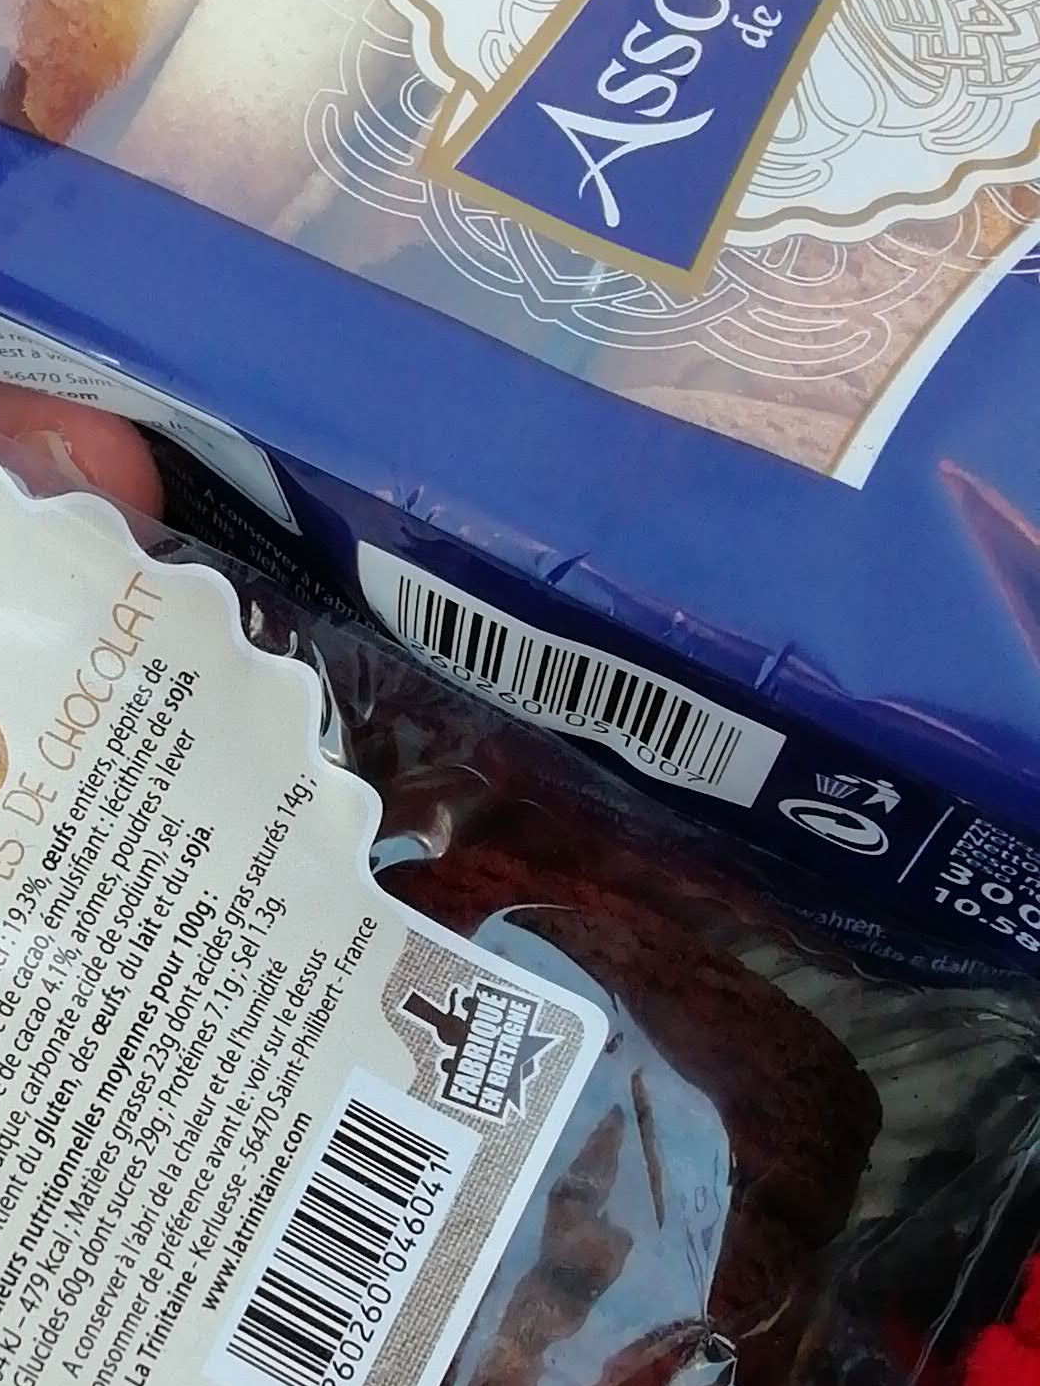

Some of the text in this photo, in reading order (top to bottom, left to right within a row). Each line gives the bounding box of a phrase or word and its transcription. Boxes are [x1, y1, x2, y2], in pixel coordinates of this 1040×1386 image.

[735, 2, 783, 52] de
[29, 566, 173, 775] CHOCOLAT
[566, 711, 704, 787] 051007
[0, 874, 54, 934] 19.3%,
[39, 819, 78, 873] œufs
[67, 755, 119, 823] entiers,
[104, 682, 154, 759] pépites
[140, 656, 169, 685] de
[0, 769, 61, 829] DE
[10, 933, 57, 990] cacao,
[95, 736, 160, 820] lécithine
[144, 709, 174, 738] de
[162, 668, 201, 713] soja,
[159, 865, 191, 896] du
[178, 824, 216, 870] soja.
[11, 994, 53, 1053] cacao
[39, 944, 84, 996] 4.1%,
[68, 870, 125, 945] arômes,
[108, 788, 163, 874] poudres
[152, 726, 196, 778] lever
[18, 1006, 82, 1106] carbonate
[69, 954, 109, 1009] acide
[93, 926, 124, 956] de
[111, 847, 171, 930] sodium),
[155, 812, 186, 849] sel.
[114, 950, 145, 981] du
[125, 914, 164, 954] lait
[89, 982, 133, 1037] œufs,
[283, 946, 328, 1009] dessus
[66, 1033, 100, 1074] des
[261, 1023, 288, 1058] sur
[270, 1006, 298, 1028] le
[448, 987, 509, 1105] FABRIQUÉ
[485, 998, 531, 1088] BRETAGNE
[17, 1271, 50, 1314] 479
[61, 1138, 122, 1227] Matières
[110, 1068, 158, 1146] grasses
[141, 1030, 182, 1074] 23g
[162, 982, 204, 1033] dont
[190, 923, 234, 987] acides
[222, 882, 256, 931] gras
[243, 817, 290, 888] saturés
[17, 1100, 107, 1254] nutritionnelles
[94, 998, 160, 1105] moyennes
[147, 947, 186, 1006] pour
[55, 1264, 96, 1308] 60g
[76, 1213, 118, 1267] dont
[104, 1153, 148, 1220] sucres
[155, 1017, 219, 1110] Protéines
[229, 932, 262, 971] Sel
[246, 894, 288, 937] 1.3g.
[241, 1051, 273, 1094] voir
[31, 1076, 84, 1150] gluten,
[134, 1268, 199, 1361] Trinitaine
[186, 1171, 248, 1262] Kerluesse
[237, 1104, 281, 1165] 56470
[264, 981, 345, 1110] Saint-Philibert
[332, 915, 379, 977] France
[203, 1113, 243, 1170] avant
[13, 1143, 44, 1176] du
[72, 1264, 129, 1361] conserver
[146, 1180, 174, 1209] de
[170, 1091, 218, 1163] chaleur
[214, 1047, 243, 1075] de
[152, 1166, 216, 1272] préférence
[199, 1110, 314, 1312] www.latrinitaine.com
[379, 1157, 455, 1275] 046041
[137, 1265, 166, 1295] de
